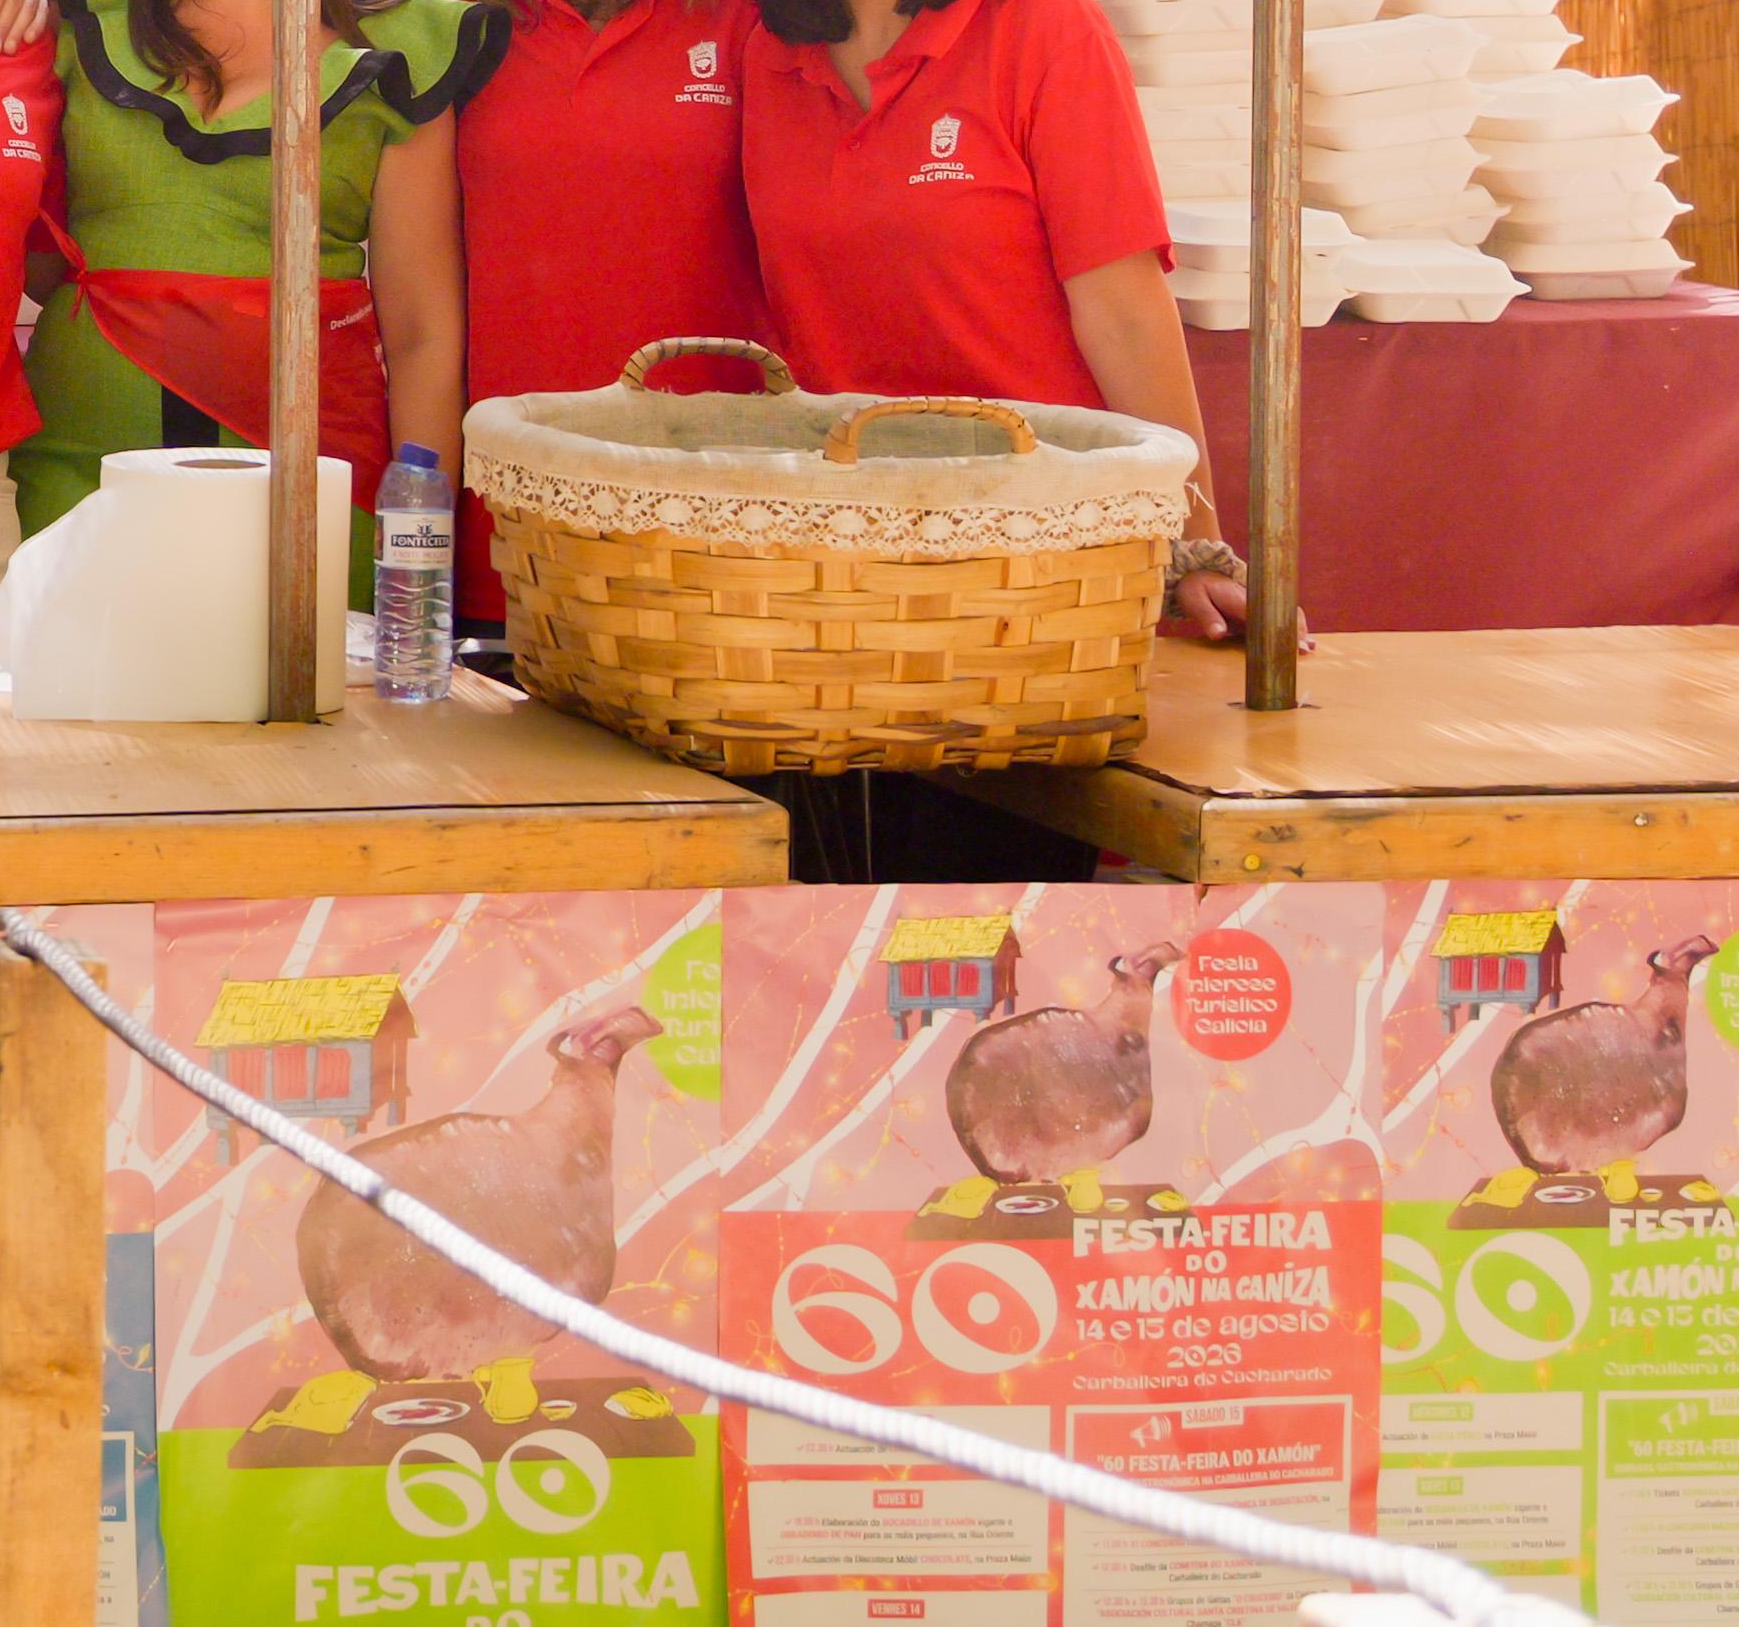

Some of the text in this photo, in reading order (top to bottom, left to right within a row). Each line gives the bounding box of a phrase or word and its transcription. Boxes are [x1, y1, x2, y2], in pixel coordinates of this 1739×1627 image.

[675, 94, 692, 103] DA
[909, 174, 925, 185] DA
[1073, 1211, 1333, 1258] FESTA-FEIRA
[1186, 1250, 1227, 1273] DO
[1076, 1268, 1195, 1312] XAMÓN
[1201, 1277, 1231, 1302] NA
[1610, 1257, 1724, 1300] XAMÓN
[772, 1243, 1058, 1374] 60
[1609, 1306, 1635, 1327] 14
[1077, 1309, 1330, 1340] 14 e 15 de agosto
[1167, 1342, 1242, 1369] 2026
[1233, 1449, 1252, 1467] DO
[386, 1429, 611, 1538] 60
[295, 1550, 699, 1623] FESTA-FEIRA
